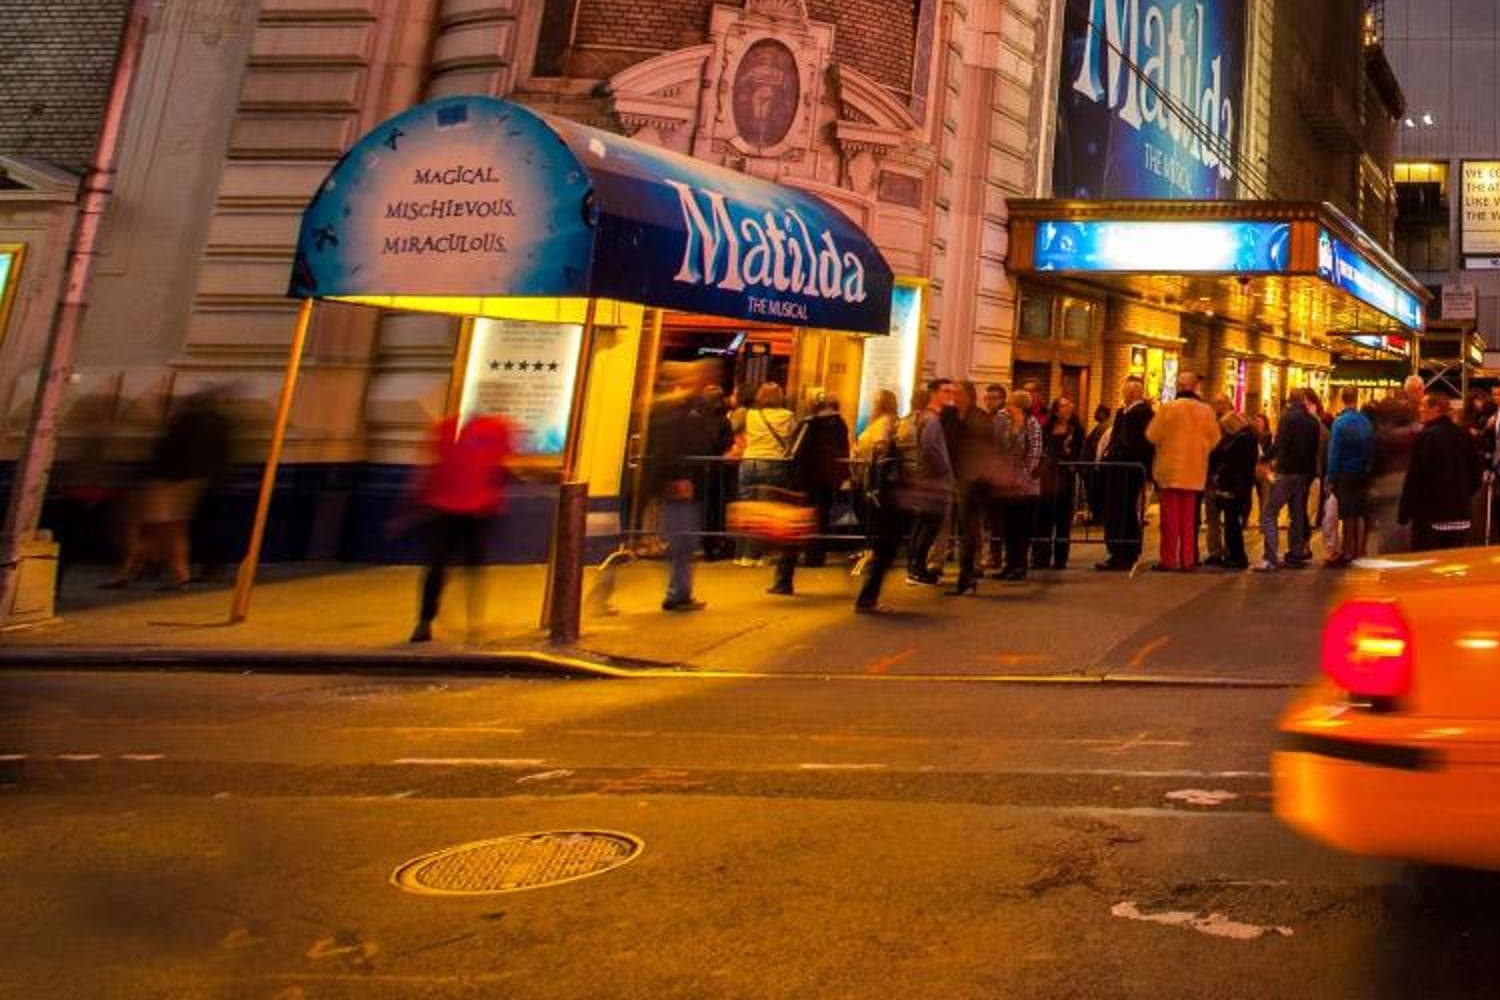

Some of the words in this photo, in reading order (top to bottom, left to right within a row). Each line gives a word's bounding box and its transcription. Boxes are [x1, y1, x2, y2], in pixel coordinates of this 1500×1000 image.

[1465, 168, 1484, 178] WE
[384, 199, 516, 220] MISCHIEVOUS.
[1465, 197, 1489, 207] LIKE
[1466, 211, 1486, 221] THE
[664, 179, 867, 303] Matilda
[748, 296, 768, 315] THE
[769, 299, 807, 320] MUSICAL
